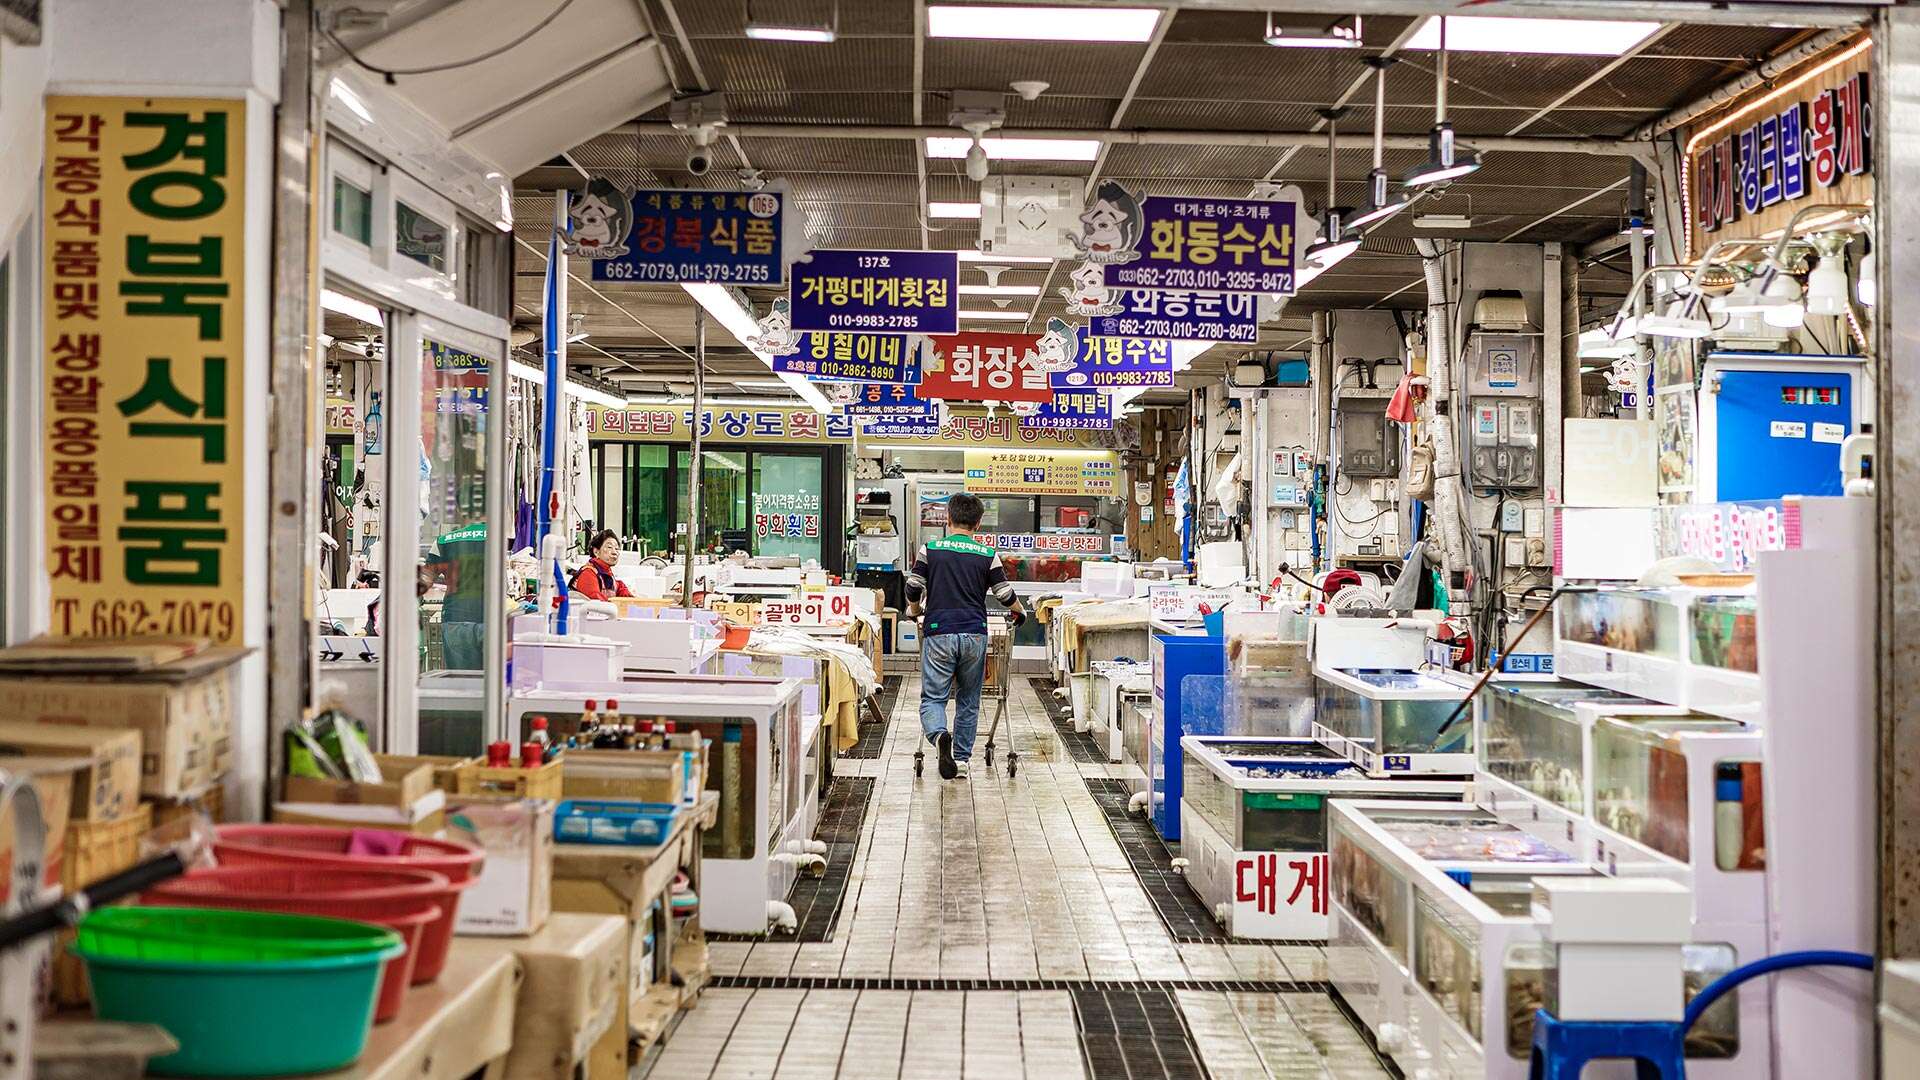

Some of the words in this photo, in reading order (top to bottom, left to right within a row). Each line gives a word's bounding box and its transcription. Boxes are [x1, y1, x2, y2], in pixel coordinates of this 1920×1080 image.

[51, 114, 104, 322] 각종식품및
[637, 216, 777, 256] 경북식품
[1150, 218, 1294, 266] 화동수산
[605, 263, 769, 282] 662-7079,011-379-2755
[857, 256, 891, 270] 137호
[800, 277, 949, 309] 거평대게횟집
[1118, 271, 1292, 291] 033)662-2703,010-3295-8472
[829, 315, 919, 329] 010-9983-2785
[1118, 319, 1256, 341] 662-2703,010-2780-8472
[116, 111, 230, 588] 경북식품
[1083, 337, 1169, 366] 거평수산
[821, 360, 895, 381] 010-2862-8890
[950, 344, 1049, 391] 화장실
[1093, 370, 1171, 386] 010-9983-2785
[603, 409, 676, 434] 회덮밥
[1028, 417, 1109, 429] 010-9983-2785
[50, 332, 104, 585] 생활용품일체
[754, 512, 819, 538] 명화횟집
[999, 534, 1034, 550] 회덮밥
[1036, 535, 1072, 550] 매운탕
[1074, 536, 1103, 551] 맛집!
[765, 603, 822, 624] 골뱅이
[1236, 854, 1329, 916] 대게
